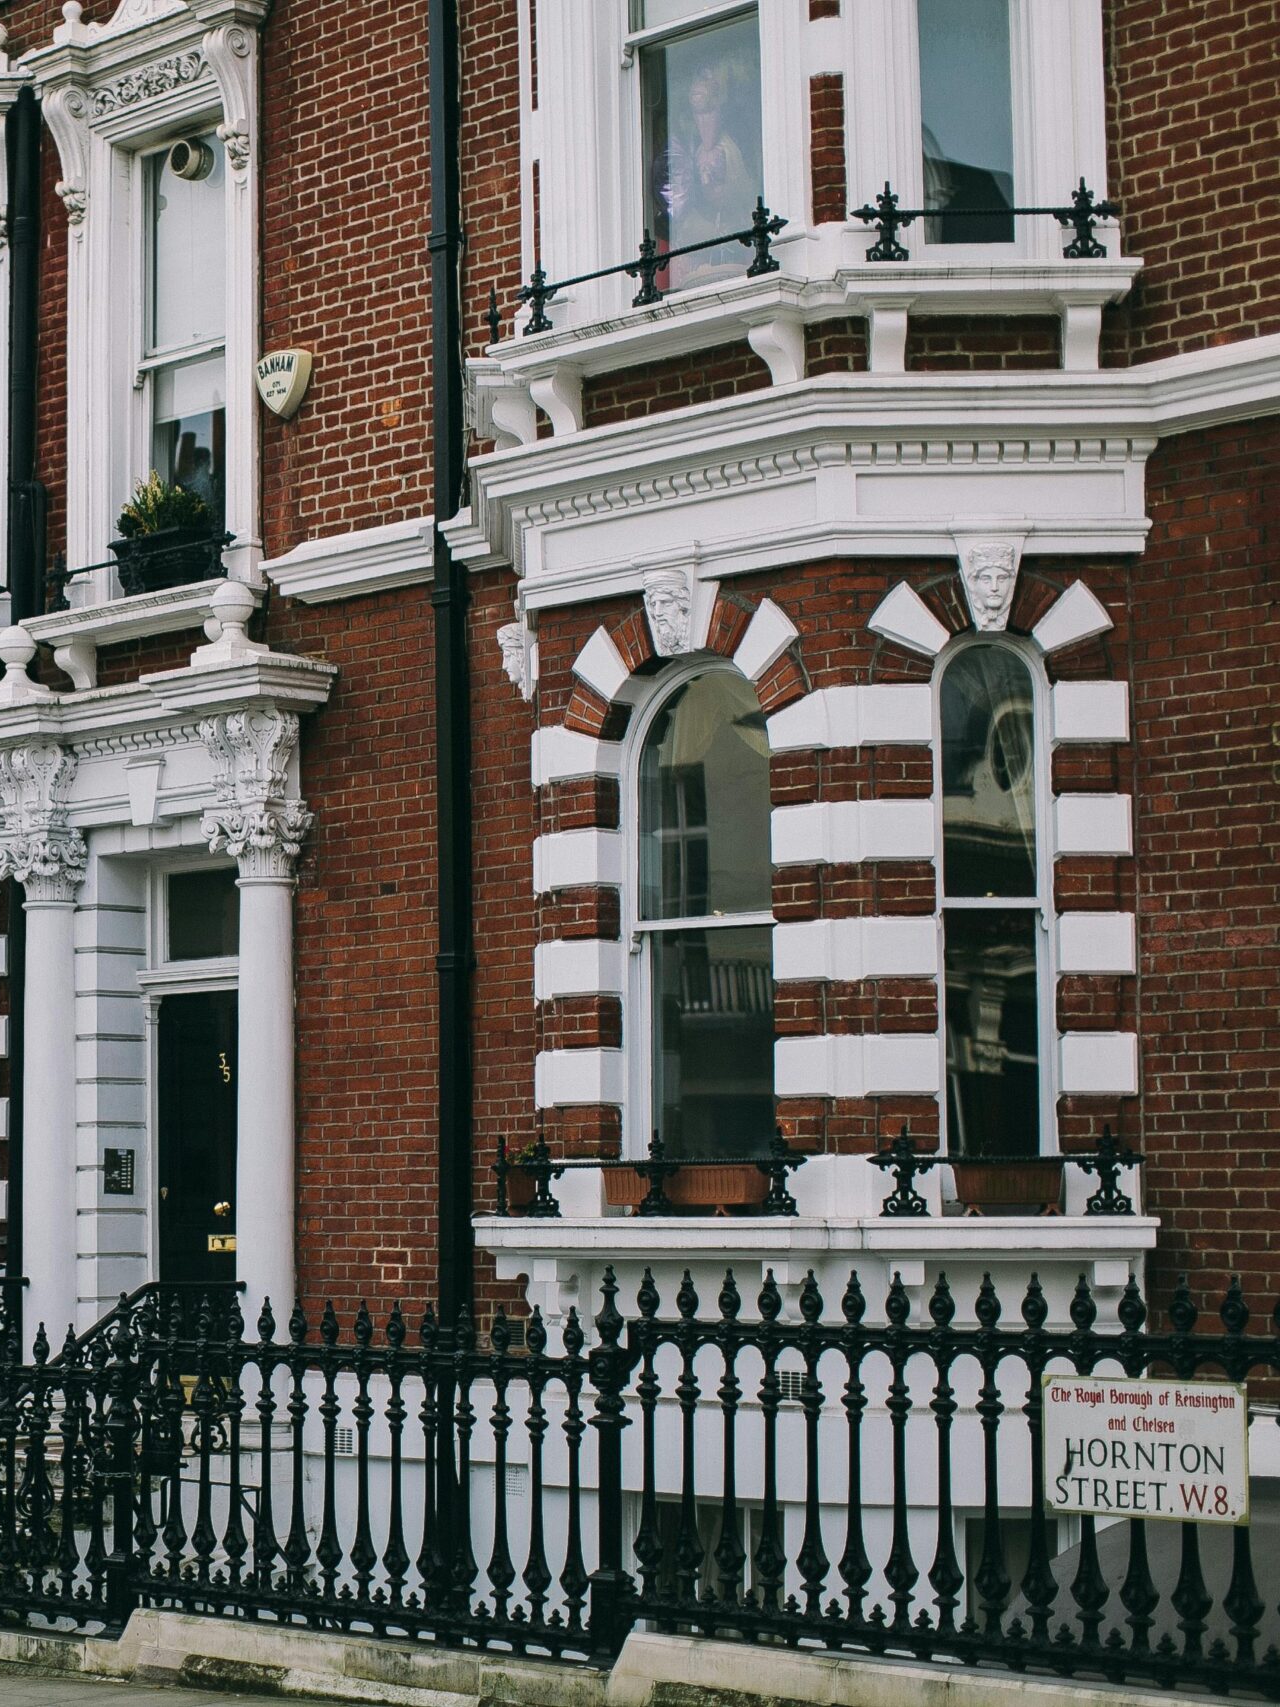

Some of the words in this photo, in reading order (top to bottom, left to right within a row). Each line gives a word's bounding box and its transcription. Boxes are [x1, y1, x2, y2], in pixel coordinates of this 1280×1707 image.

[257, 356, 294, 380] BANHAM
[1051, 1387, 1071, 1402] The
[1075, 1388, 1105, 1408] Royal
[1110, 1389, 1153, 1410] Borough
[1159, 1391, 1171, 1406] of
[1175, 1390, 1235, 1413] Kensington
[1108, 1416, 1126, 1431] and
[1133, 1416, 1175, 1433] Chelsea
[1065, 1438, 1224, 1475] HORNTON
[1179, 1483, 1236, 1516] W.8.
